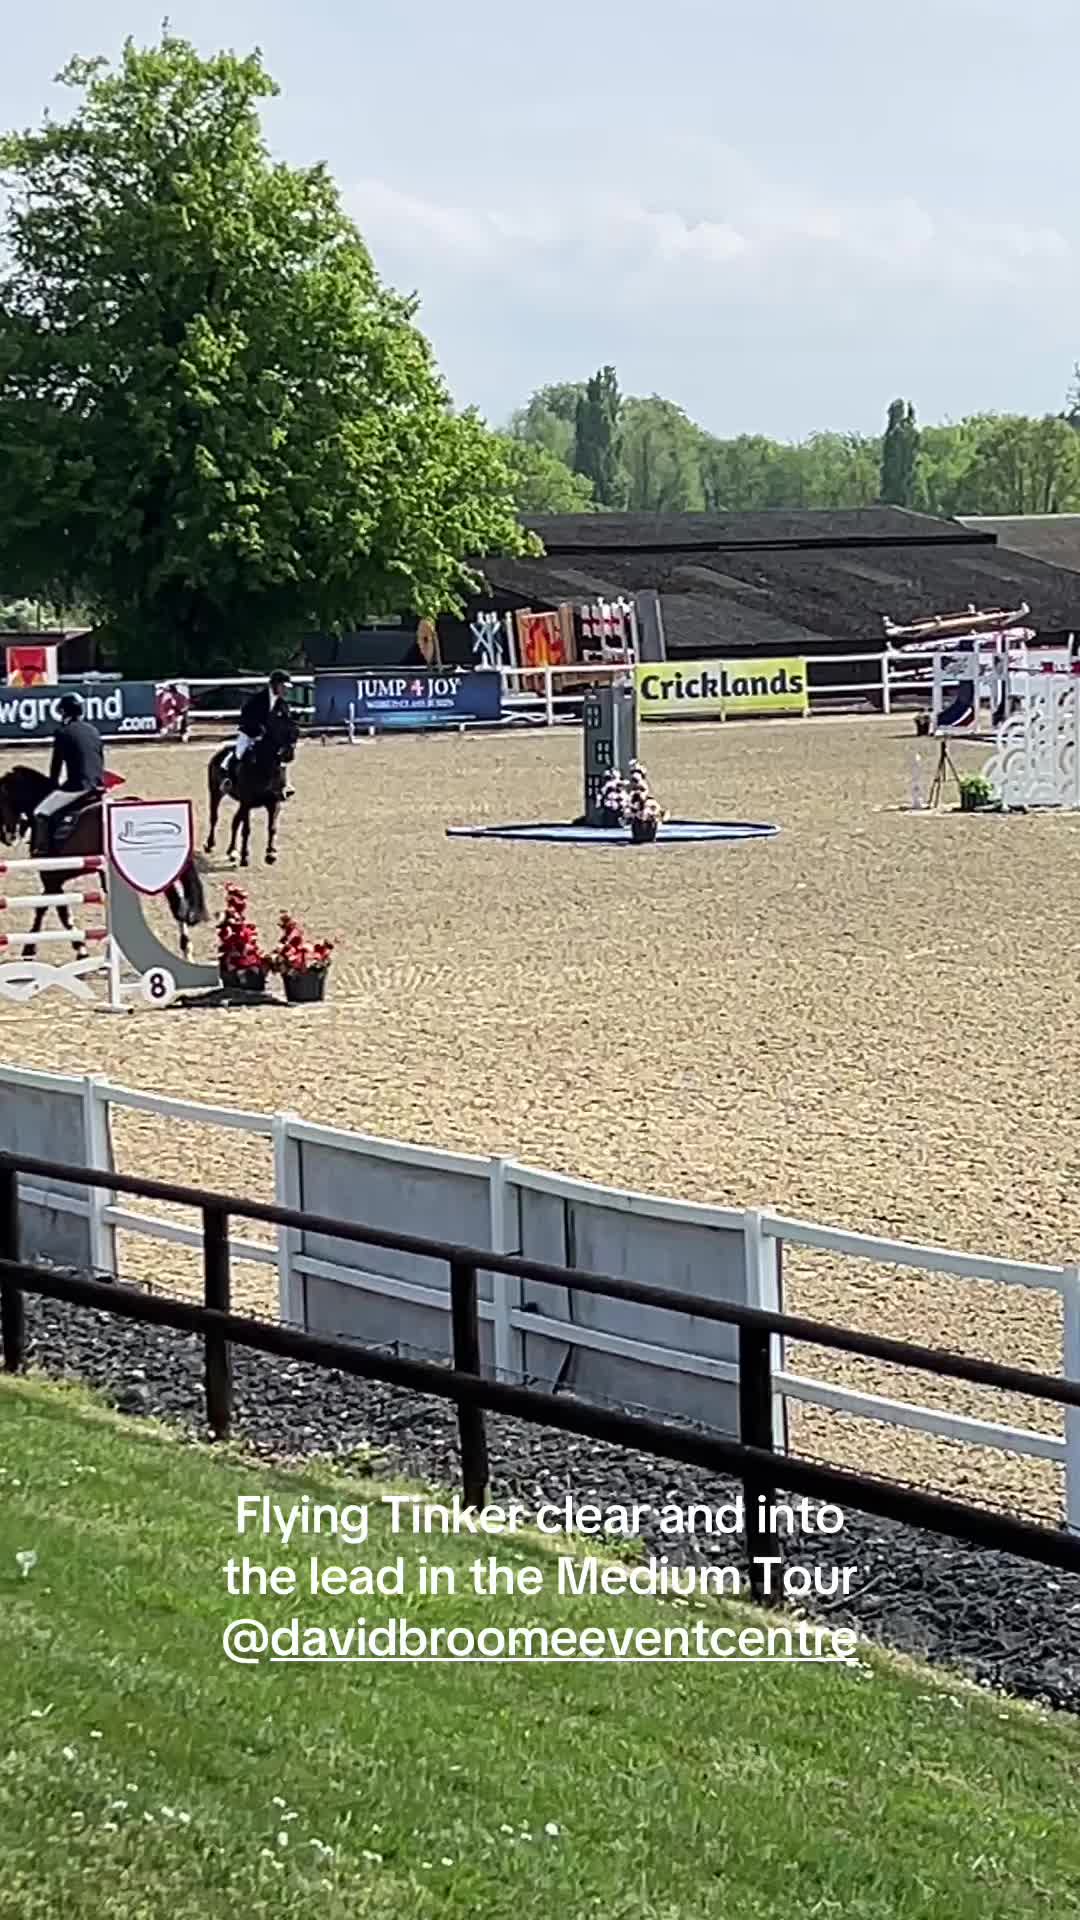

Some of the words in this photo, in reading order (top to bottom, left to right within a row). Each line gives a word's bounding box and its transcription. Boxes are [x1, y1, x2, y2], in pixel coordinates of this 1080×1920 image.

[357, 679, 407, 700] JUMP
[410, 679, 425, 697] 4
[427, 677, 460, 698] JOY
[640, 668, 804, 701] Cricklands
[0, 688, 123, 730] wgrond
[117, 716, 157, 731] .com
[150, 972, 167, 999] 8
